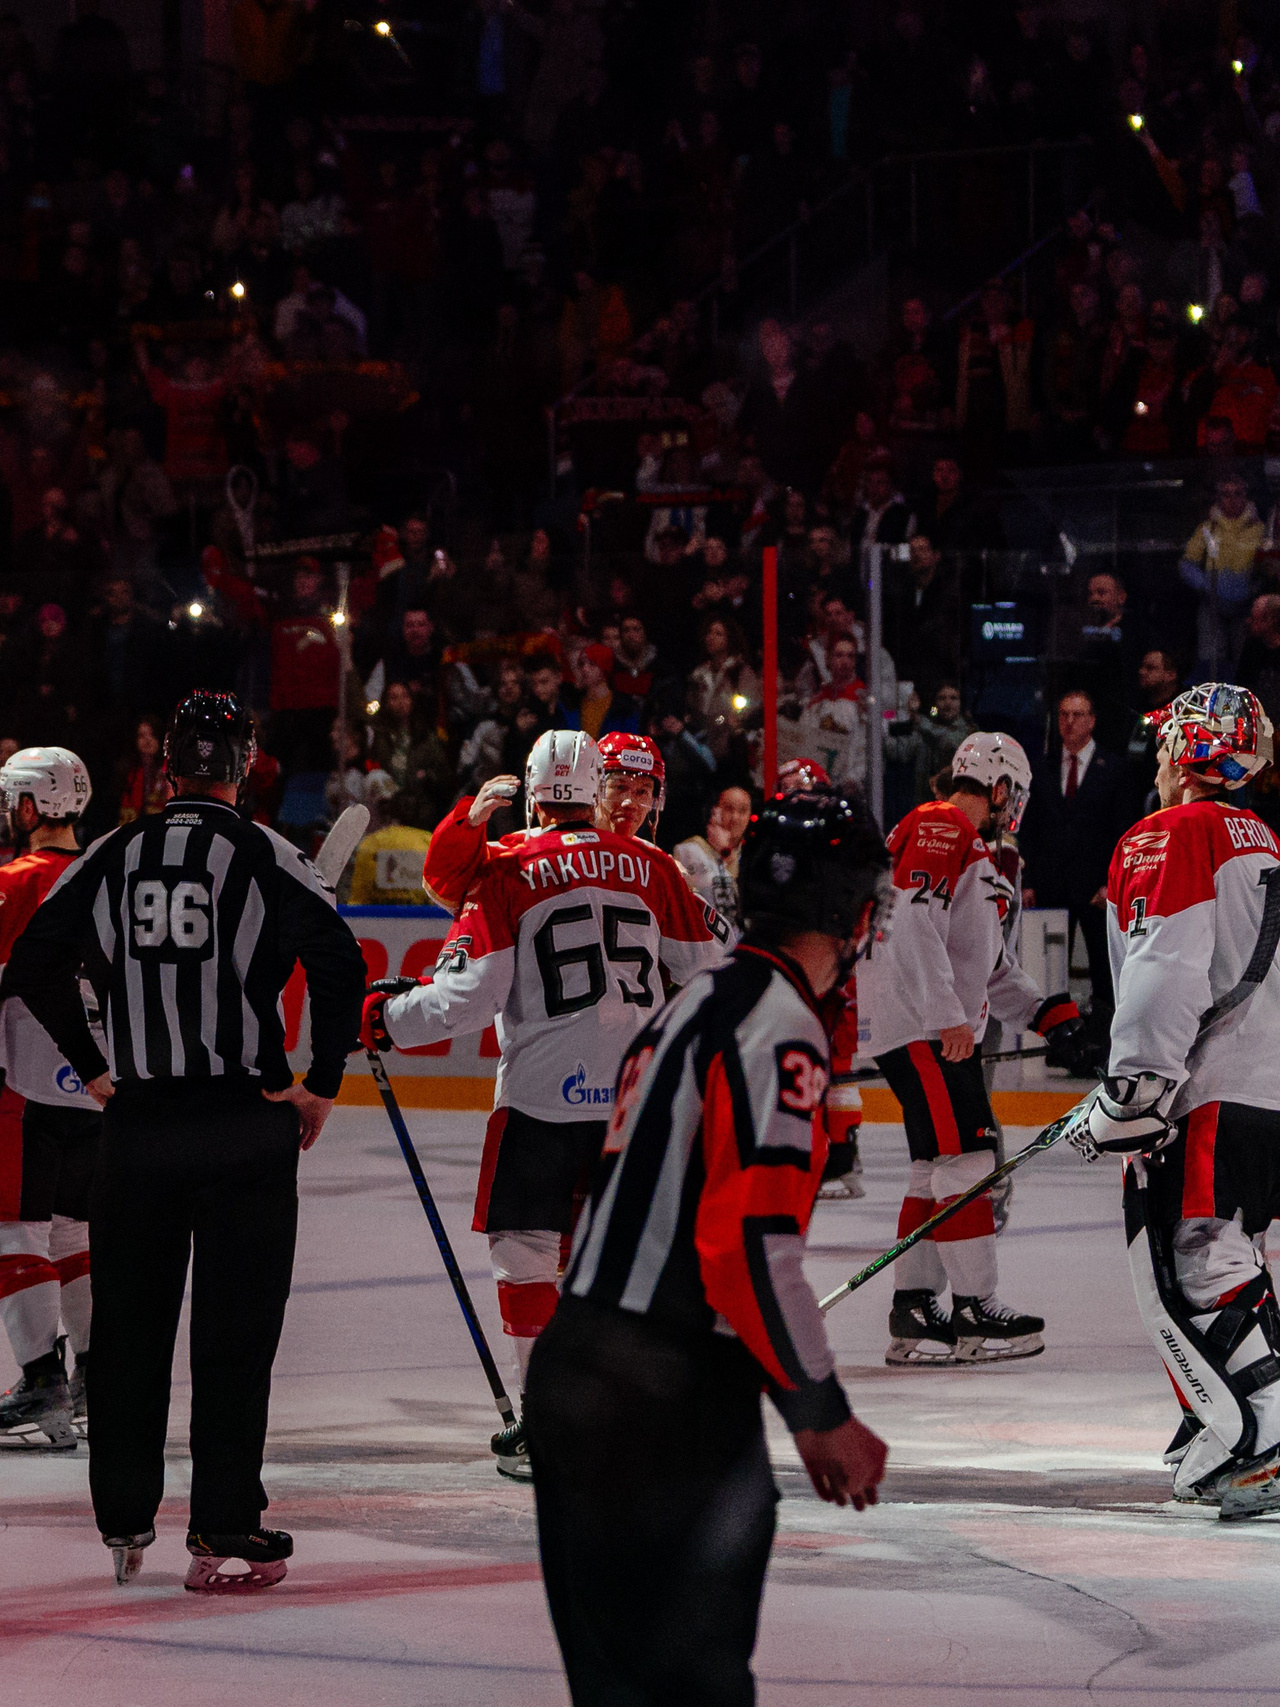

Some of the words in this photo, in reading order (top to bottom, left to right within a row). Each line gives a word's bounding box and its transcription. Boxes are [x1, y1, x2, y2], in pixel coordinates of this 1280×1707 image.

[623, 753, 652, 766] согаз
[74, 775, 87, 792] 66
[553, 784, 572, 800] 65
[520, 850, 651, 891] YAKUPOV
[909, 869, 952, 911] 24
[134, 879, 210, 949] 96
[1130, 896, 1148, 938] 1
[534, 904, 655, 1018] 65
